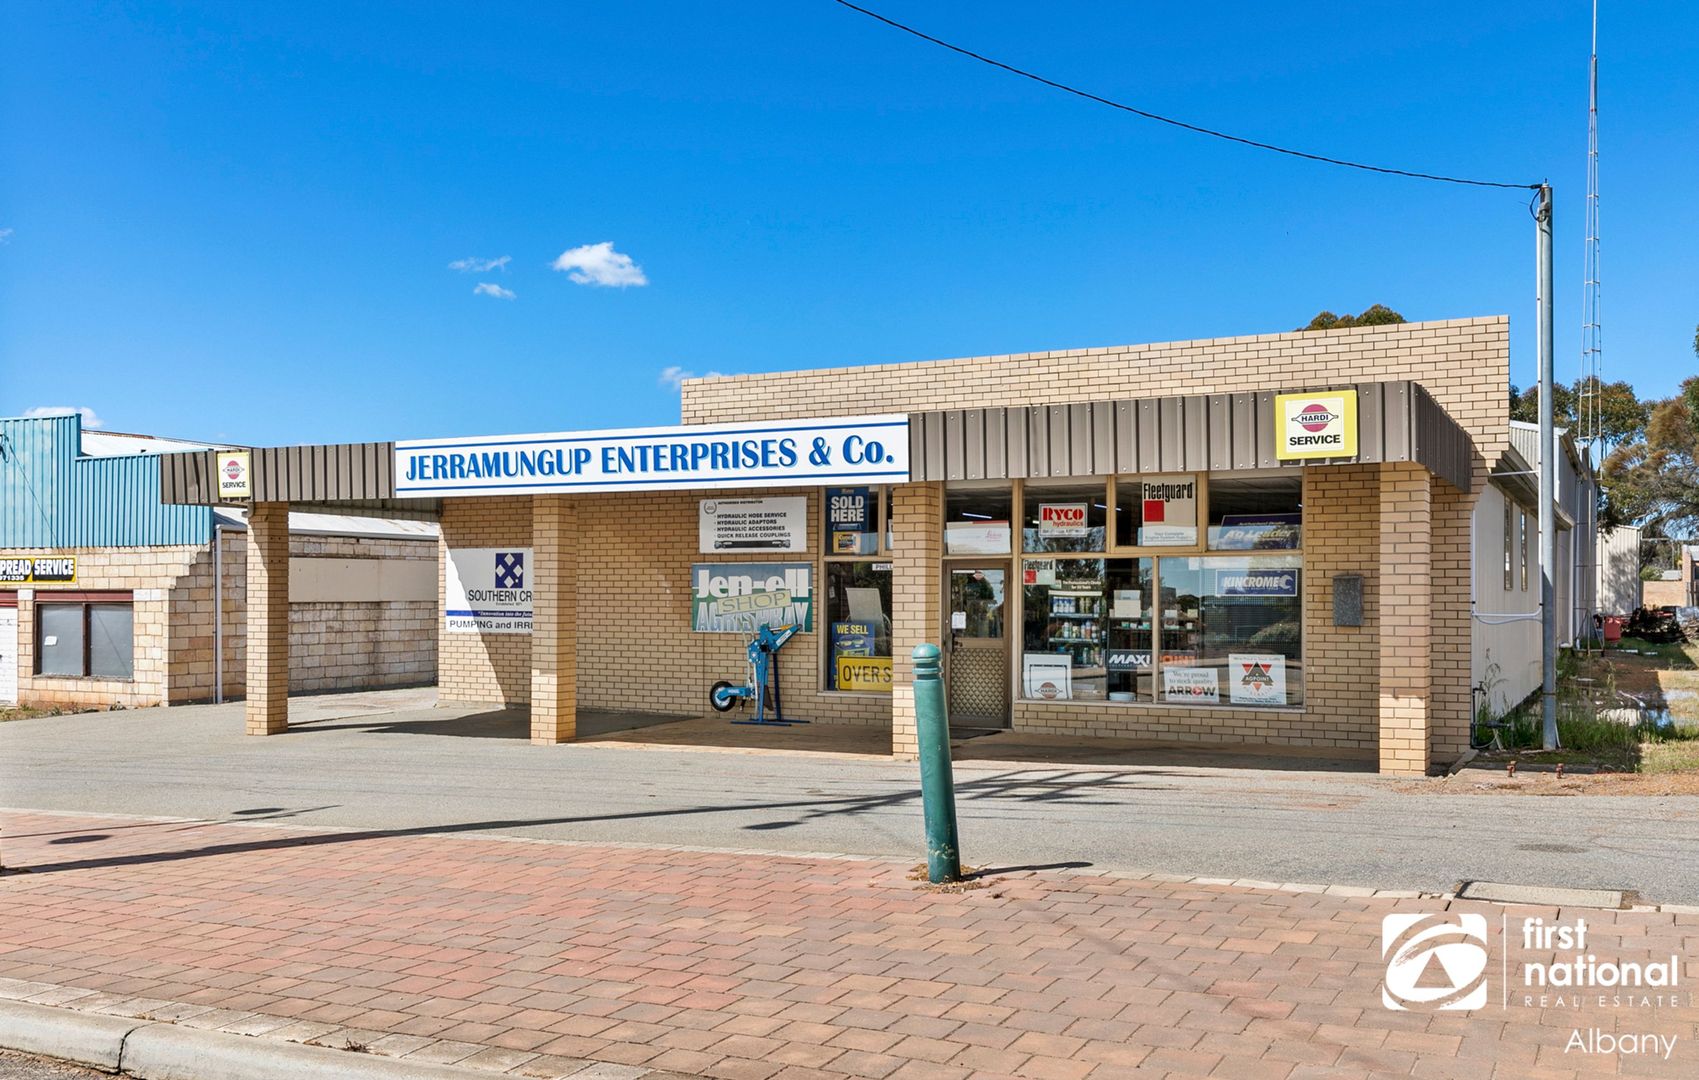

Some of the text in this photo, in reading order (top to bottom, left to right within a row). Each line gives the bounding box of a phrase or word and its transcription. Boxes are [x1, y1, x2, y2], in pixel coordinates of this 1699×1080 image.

[1301, 414, 1329, 422] HARDI
[1289, 434, 1341, 446] SERVICE
[405, 435, 895, 481] JERRAMUNGUP ENTERPRISES & Co.
[222, 481, 246, 489] SERVICE
[1143, 482, 1193, 503] Fleetguard
[830, 495, 865, 509] SOLD
[830, 508, 865, 522] HERE
[1042, 507, 1084, 521] RYCO
[0, 559, 74, 575] PREAD SERVICE
[696, 569, 809, 598] Jen-ell
[1224, 576, 1280, 587] KINCROME
[468, 590, 532, 602] SOUTHERN CR
[722, 592, 786, 612] SHOP
[450, 620, 493, 629] PUMPING
[836, 624, 868, 634] WE SELL
[1109, 654, 1151, 667] MAXI
[1168, 686, 1216, 697] ARROW
